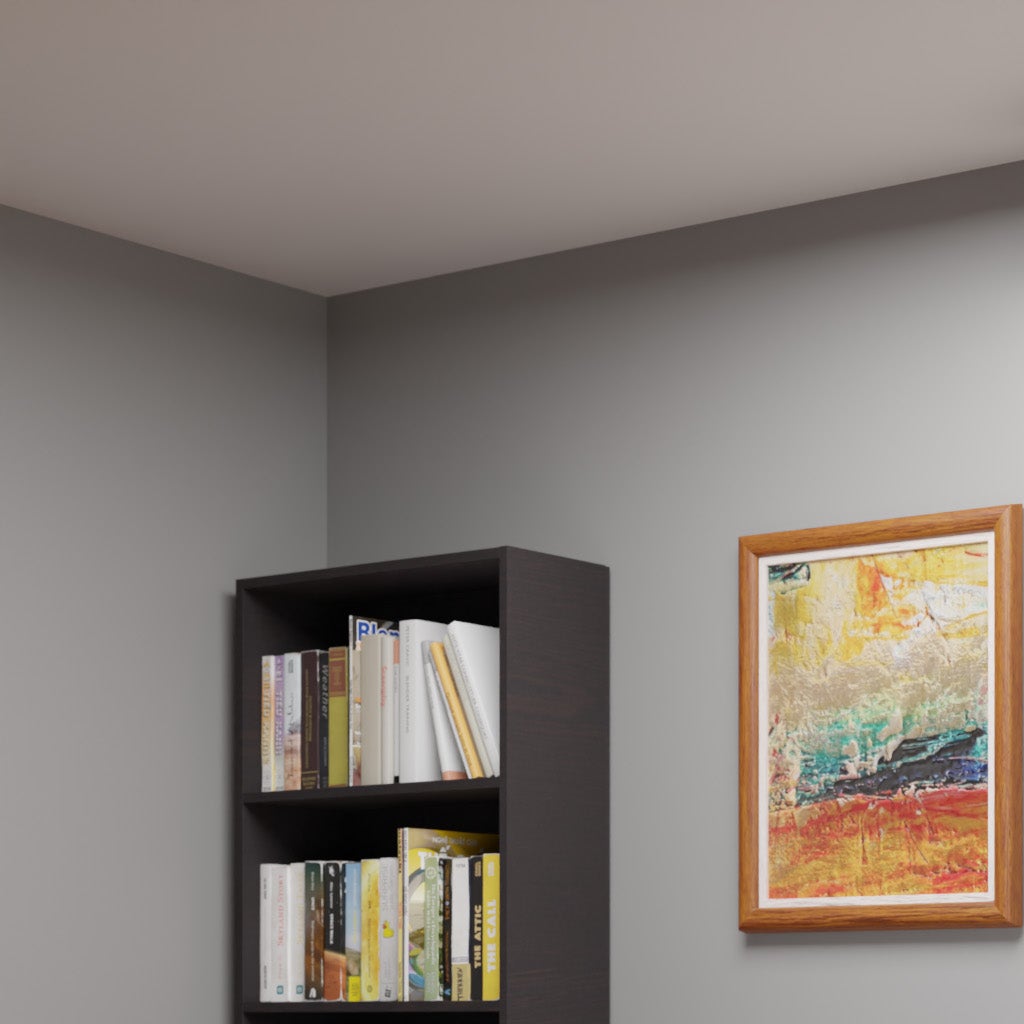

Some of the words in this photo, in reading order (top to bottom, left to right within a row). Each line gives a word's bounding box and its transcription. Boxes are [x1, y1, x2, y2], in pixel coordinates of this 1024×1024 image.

[474, 904, 482, 941] ATTIC
[486, 899, 497, 938] CALL
[474, 945, 482, 968] THE
[486, 943, 497, 973] THE
